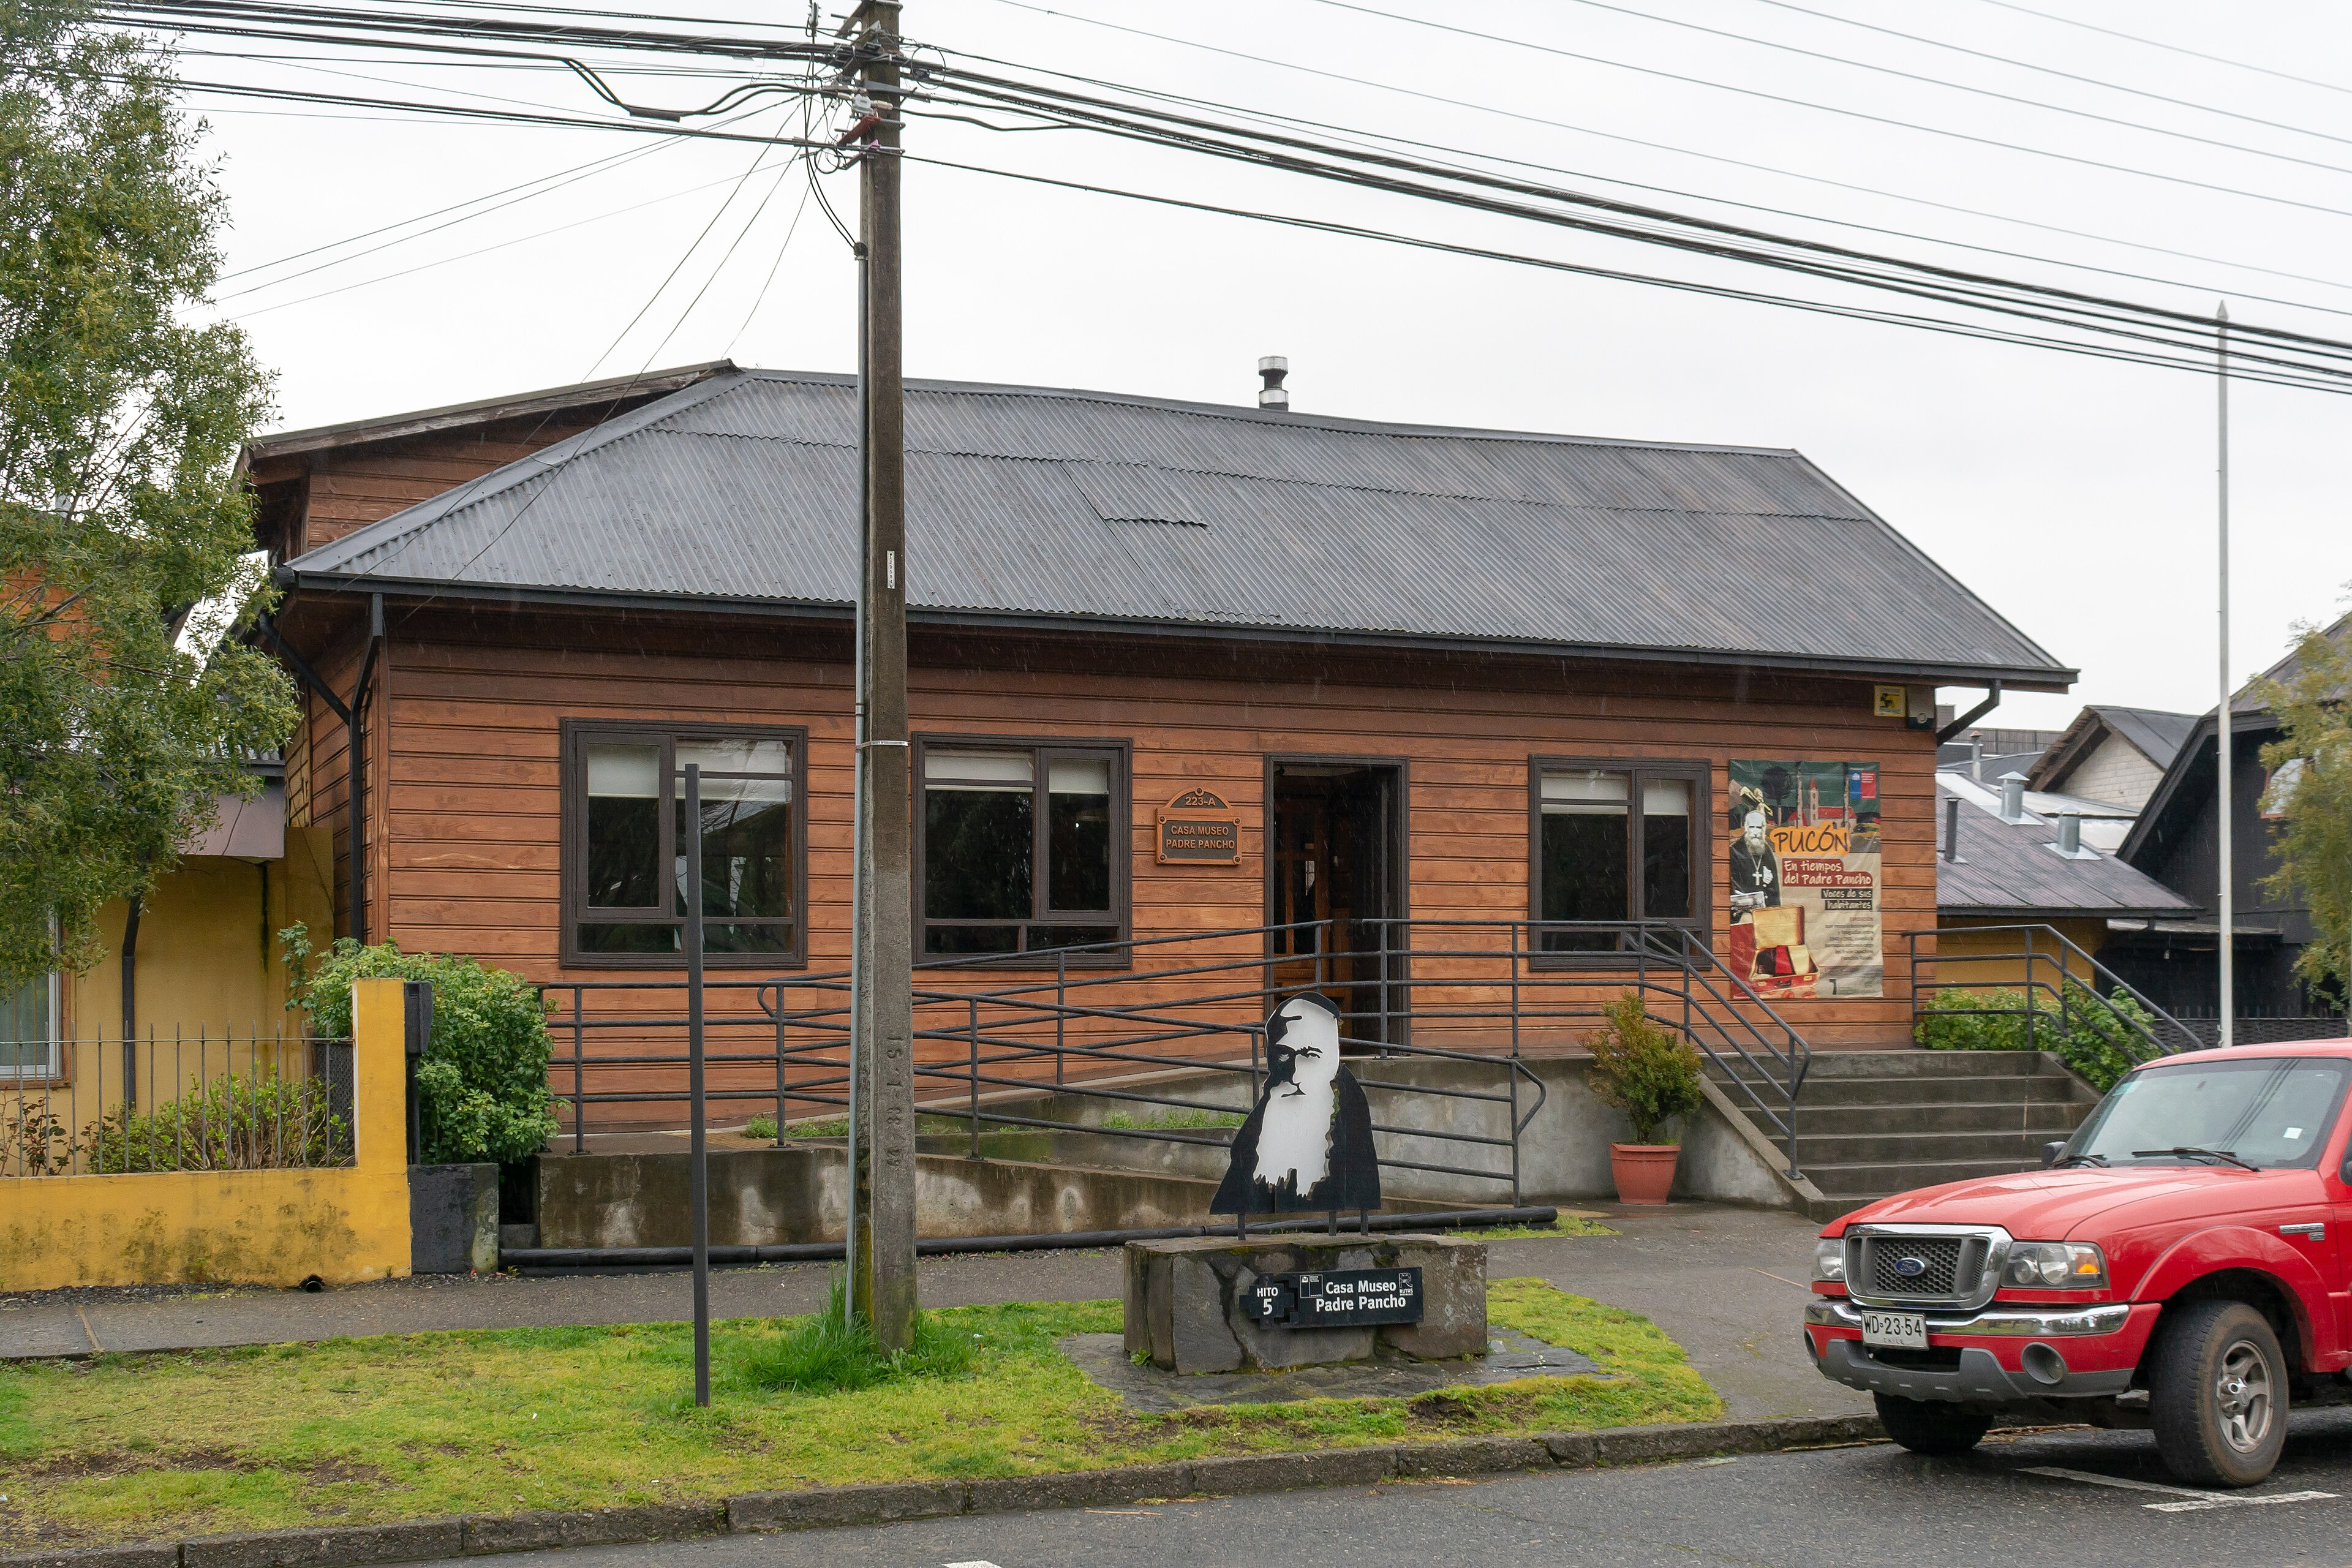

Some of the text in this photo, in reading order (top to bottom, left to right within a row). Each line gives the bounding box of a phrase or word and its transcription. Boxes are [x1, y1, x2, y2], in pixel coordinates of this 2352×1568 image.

[1185, 797, 1216, 806] 223-A
[1171, 826, 1229, 835] CASA MUSEO
[1166, 839, 1235, 849] PADRE PANCHO
[1774, 825, 1849, 853] PUCÓN
[1784, 859, 1842, 873] En tiempos
[1784, 872, 1872, 884] del Padre Pancho
[1257, 1287, 1278, 1297] HITO
[1325, 1280, 1396, 1294] Casa Museo
[1263, 1298, 1273, 1315] 5
[1316, 1294, 1406, 1312] Padre Pancho
